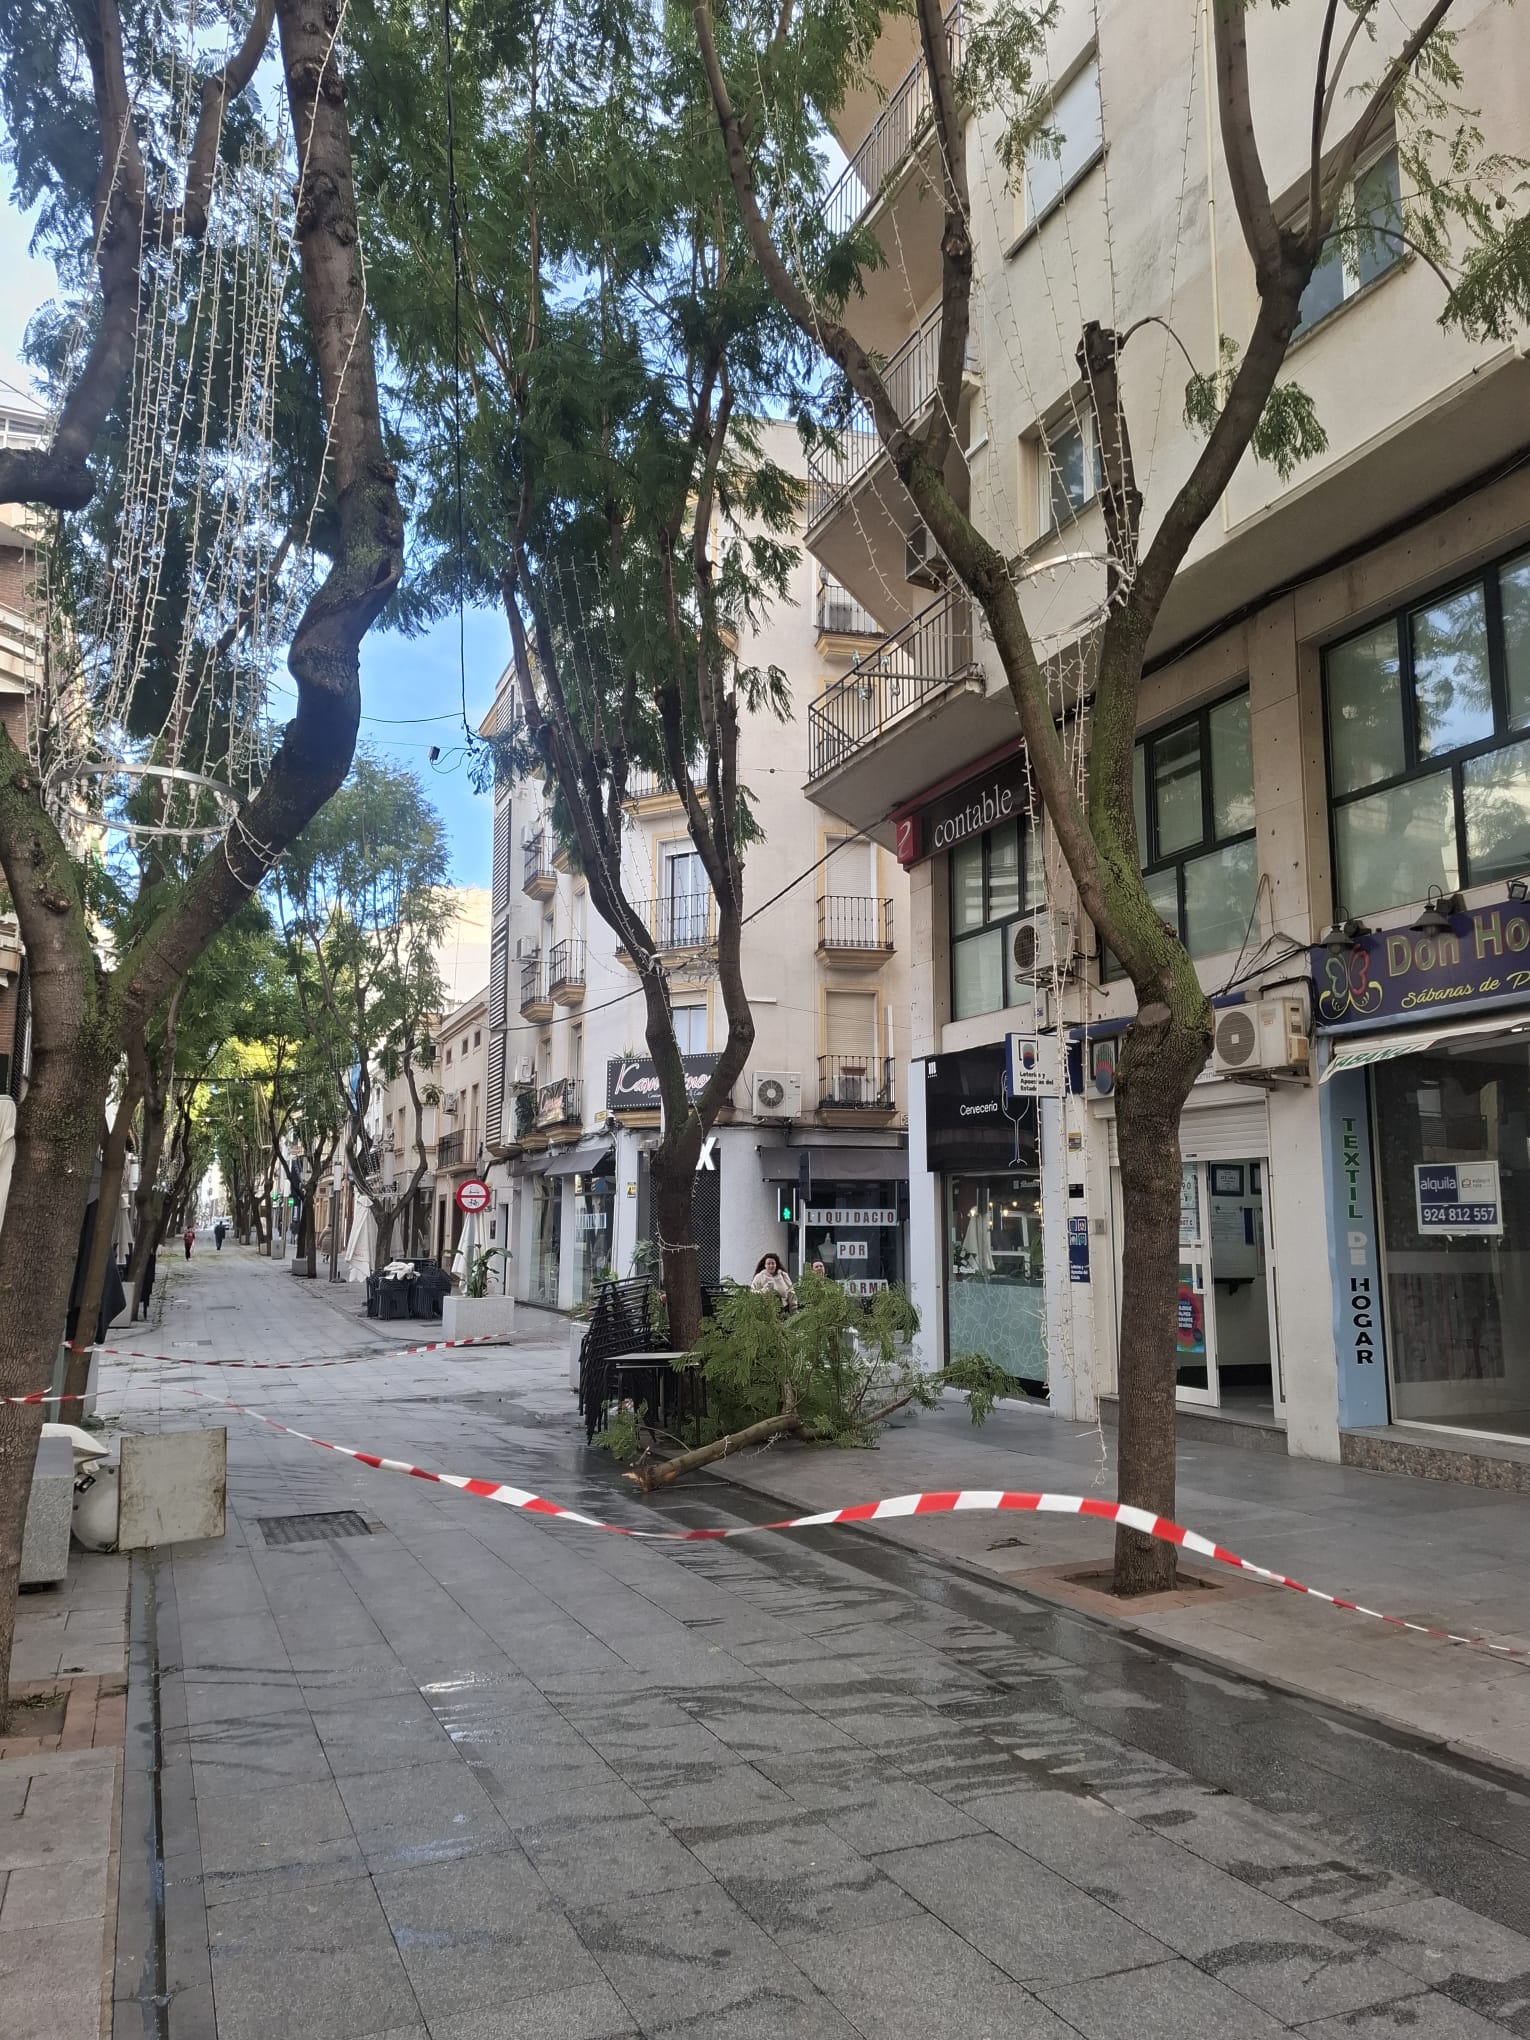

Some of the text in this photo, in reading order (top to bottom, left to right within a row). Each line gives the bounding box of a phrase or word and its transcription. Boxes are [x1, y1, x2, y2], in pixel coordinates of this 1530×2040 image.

[934, 783, 1013, 848] contable
[1387, 932, 1460, 977] Don
[1401, 984, 1475, 1009] Sábanas
[1479, 976, 1501, 991] de
[1341, 1117, 1364, 1219] TEXTIL
[1420, 1176, 1457, 1192] alquila
[1424, 1207, 1495, 1221] 924 812 557
[840, 1244, 866, 1256] POR
[1350, 1278, 1374, 1364] HOGAR
